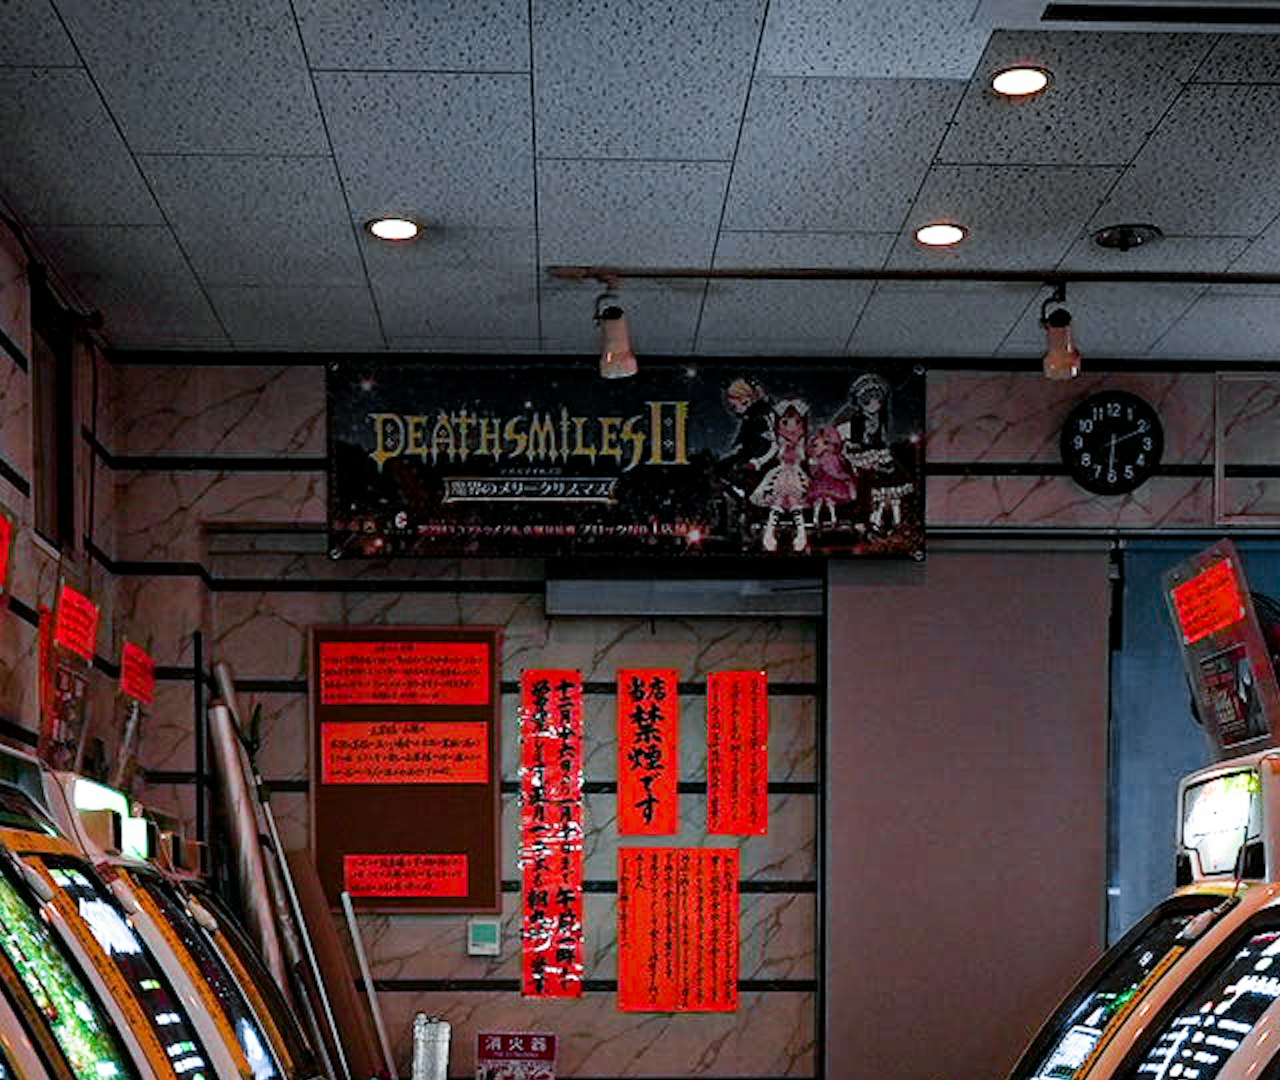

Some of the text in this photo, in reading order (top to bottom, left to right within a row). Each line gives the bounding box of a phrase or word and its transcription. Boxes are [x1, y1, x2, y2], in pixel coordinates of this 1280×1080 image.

[1092, 406, 1104, 421] 11
[1106, 402, 1122, 418] 12
[1078, 418, 1094, 433] 10
[365, 406, 645, 475] DEATHSMILES
[484, 1035, 548, 1053] 消火器
